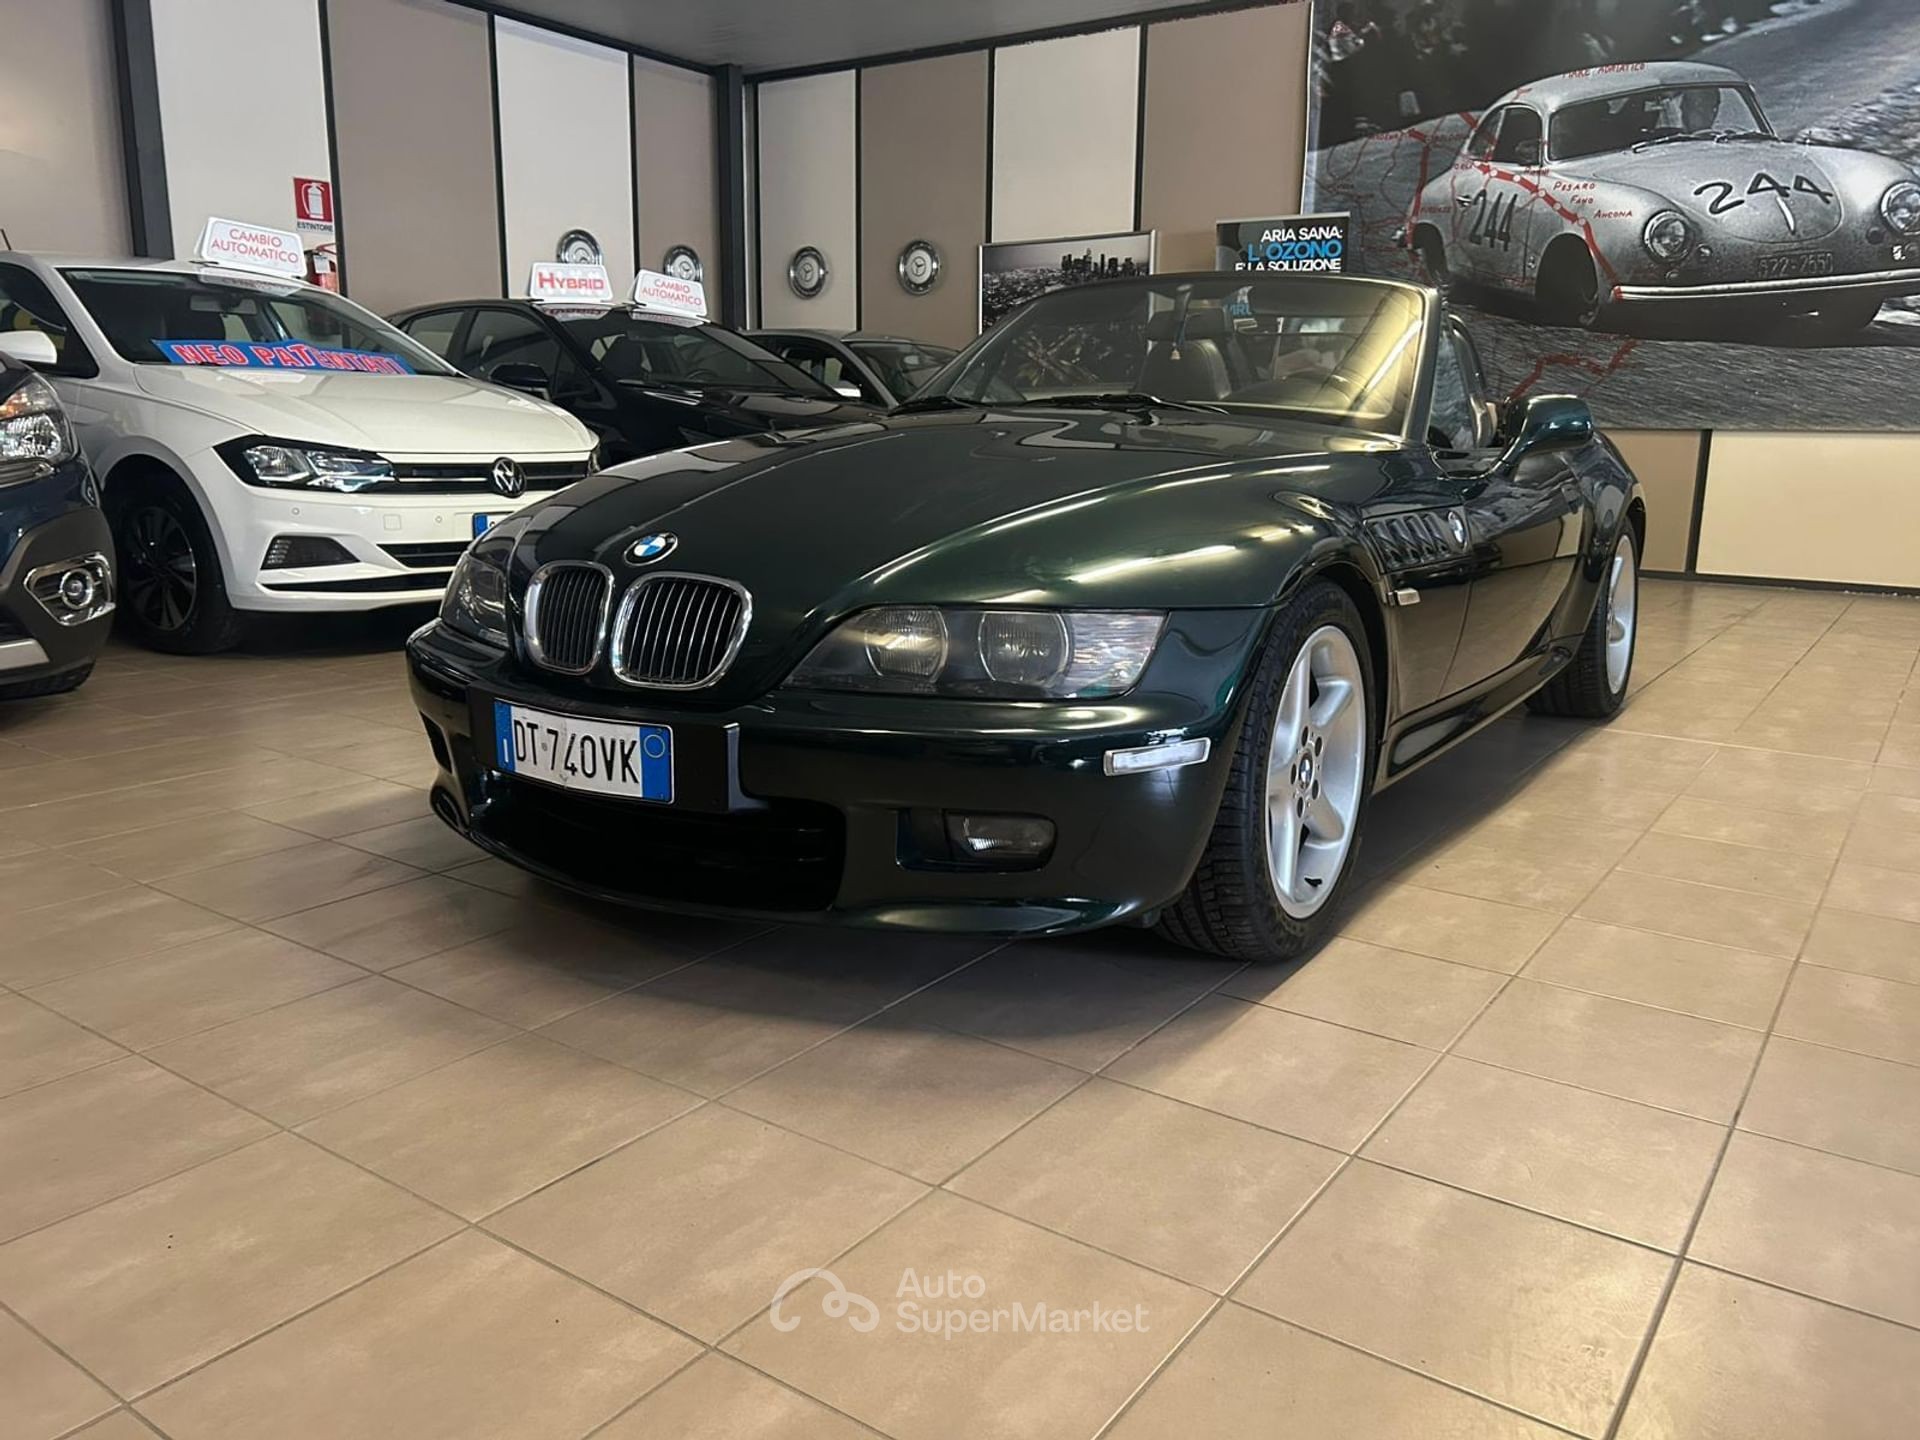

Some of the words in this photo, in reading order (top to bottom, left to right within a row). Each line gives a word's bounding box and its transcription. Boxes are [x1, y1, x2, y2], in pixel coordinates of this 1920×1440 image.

[1553, 181, 1596, 191] PESARO
[1693, 172, 1835, 215] 244
[1570, 195, 1594, 204] FANO
[1470, 189, 1518, 252] 244
[1593, 209, 1633, 219] ANCONA
[297, 222, 334, 233] ESTINTORE
[1260, 228, 1297, 243] ARIA
[1298, 225, 1344, 240] SANA:
[229, 228, 283, 248] CAMBIO
[211, 239, 299, 264] AUTOMATICO
[1267, 258, 1342, 271] SOLUZIONE
[654, 278, 690, 294] CAMBIO
[641, 287, 702, 306] AUTOMATICO
[171, 343, 249, 366] NEO
[250, 343, 410, 375] PATENTATI
[513, 719, 539, 767] DT
[547, 728, 640, 785] 740VK
